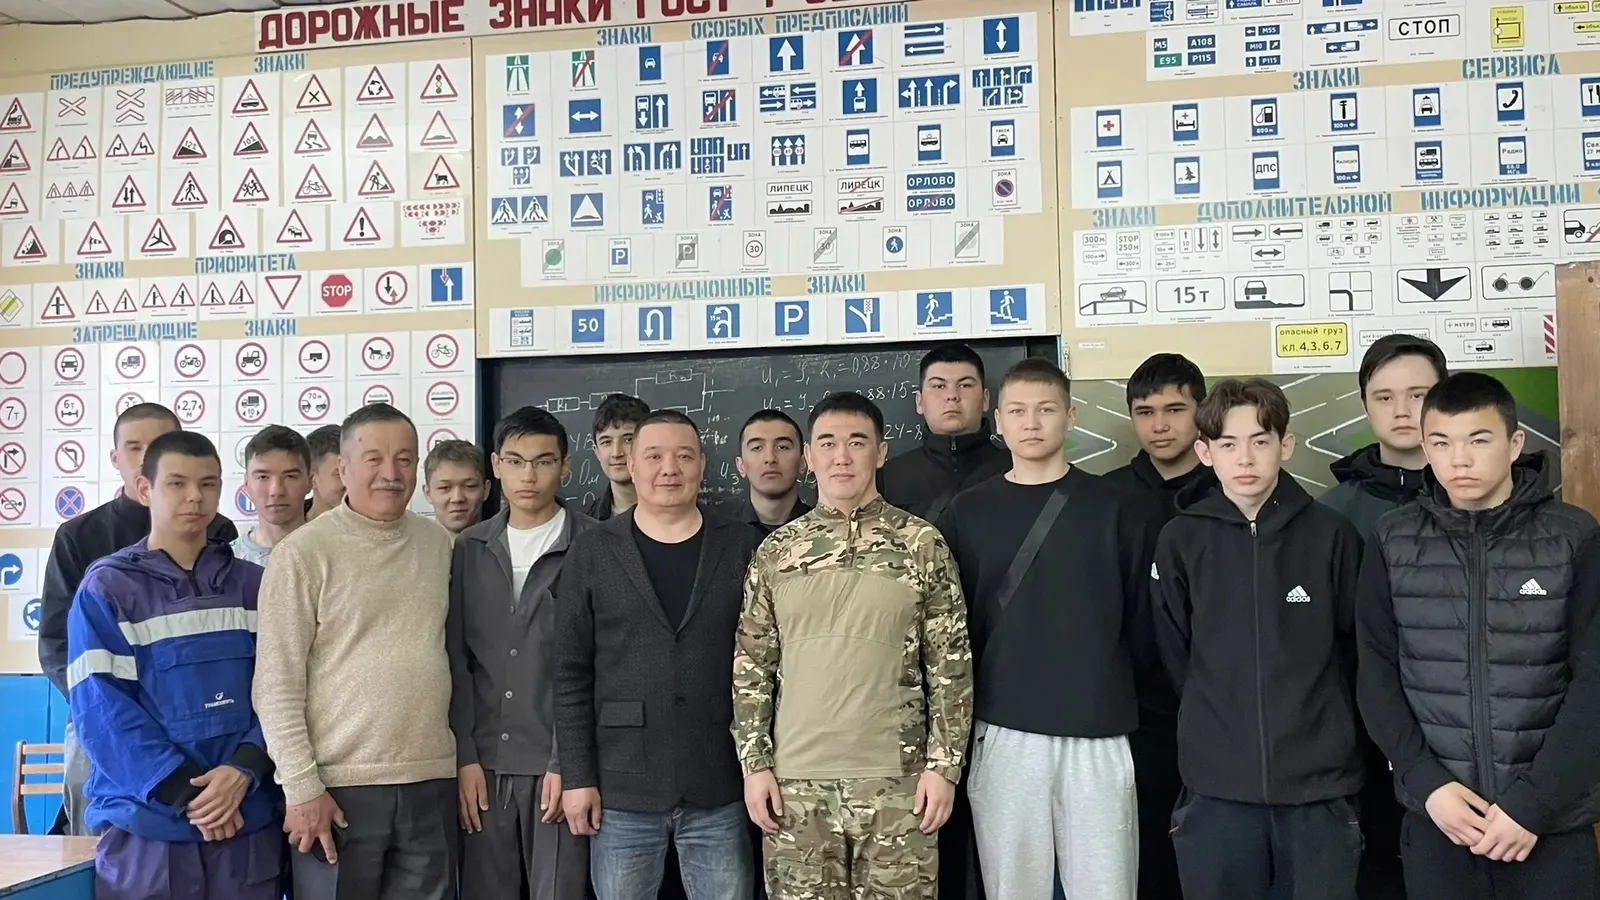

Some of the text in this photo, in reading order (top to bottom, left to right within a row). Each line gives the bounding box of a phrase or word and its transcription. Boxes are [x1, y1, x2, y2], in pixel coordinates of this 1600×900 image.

[259, 0, 466, 49] ДОРОЖНЫЕ
[489, 0, 611, 29] ЗНАКИ
[597, 3, 909, 46] ЗНАКИ ОСОБЫХ ПРЕДПИСАНИЙ
[1398, 18, 1450, 36] СТОП
[1154, 41, 1167, 49] М5
[1191, 38, 1213, 46] А108
[50, 53, 307, 90] ПРЕДУПРЕЖДАЮЩИЕ ЗНАКИ
[1293, 53, 1561, 90] ЗНАКИ СЕРВИСА
[1255, 164, 1277, 174] ДПС
[770, 182, 809, 195] ЛИПЕЦК
[840, 179, 881, 192] ЛИПЕЦК
[908, 175, 954, 189] ОРЛОВО
[908, 196, 954, 210] ОРЛОВО
[1092, 184, 1580, 228] ЗНАКИ ДОПОЛНИТЕЛЬНОЙ ИНФОРМАЦИИ
[1118, 235, 1139, 243] STOP
[749, 245, 760, 253] 30
[75, 253, 296, 280] ЗНАКИ ПРИОРИТЕТА
[323, 285, 352, 297] STOP
[594, 274, 865, 302] ИНФОРМАЦИОННЫЕ ЗНАКИ
[73, 319, 296, 343] ЗАПРЕЩАЮЩИЕ ЗНАКИ
[578, 318, 599, 332] 50
[1280, 328, 1343, 336] опасный груз
